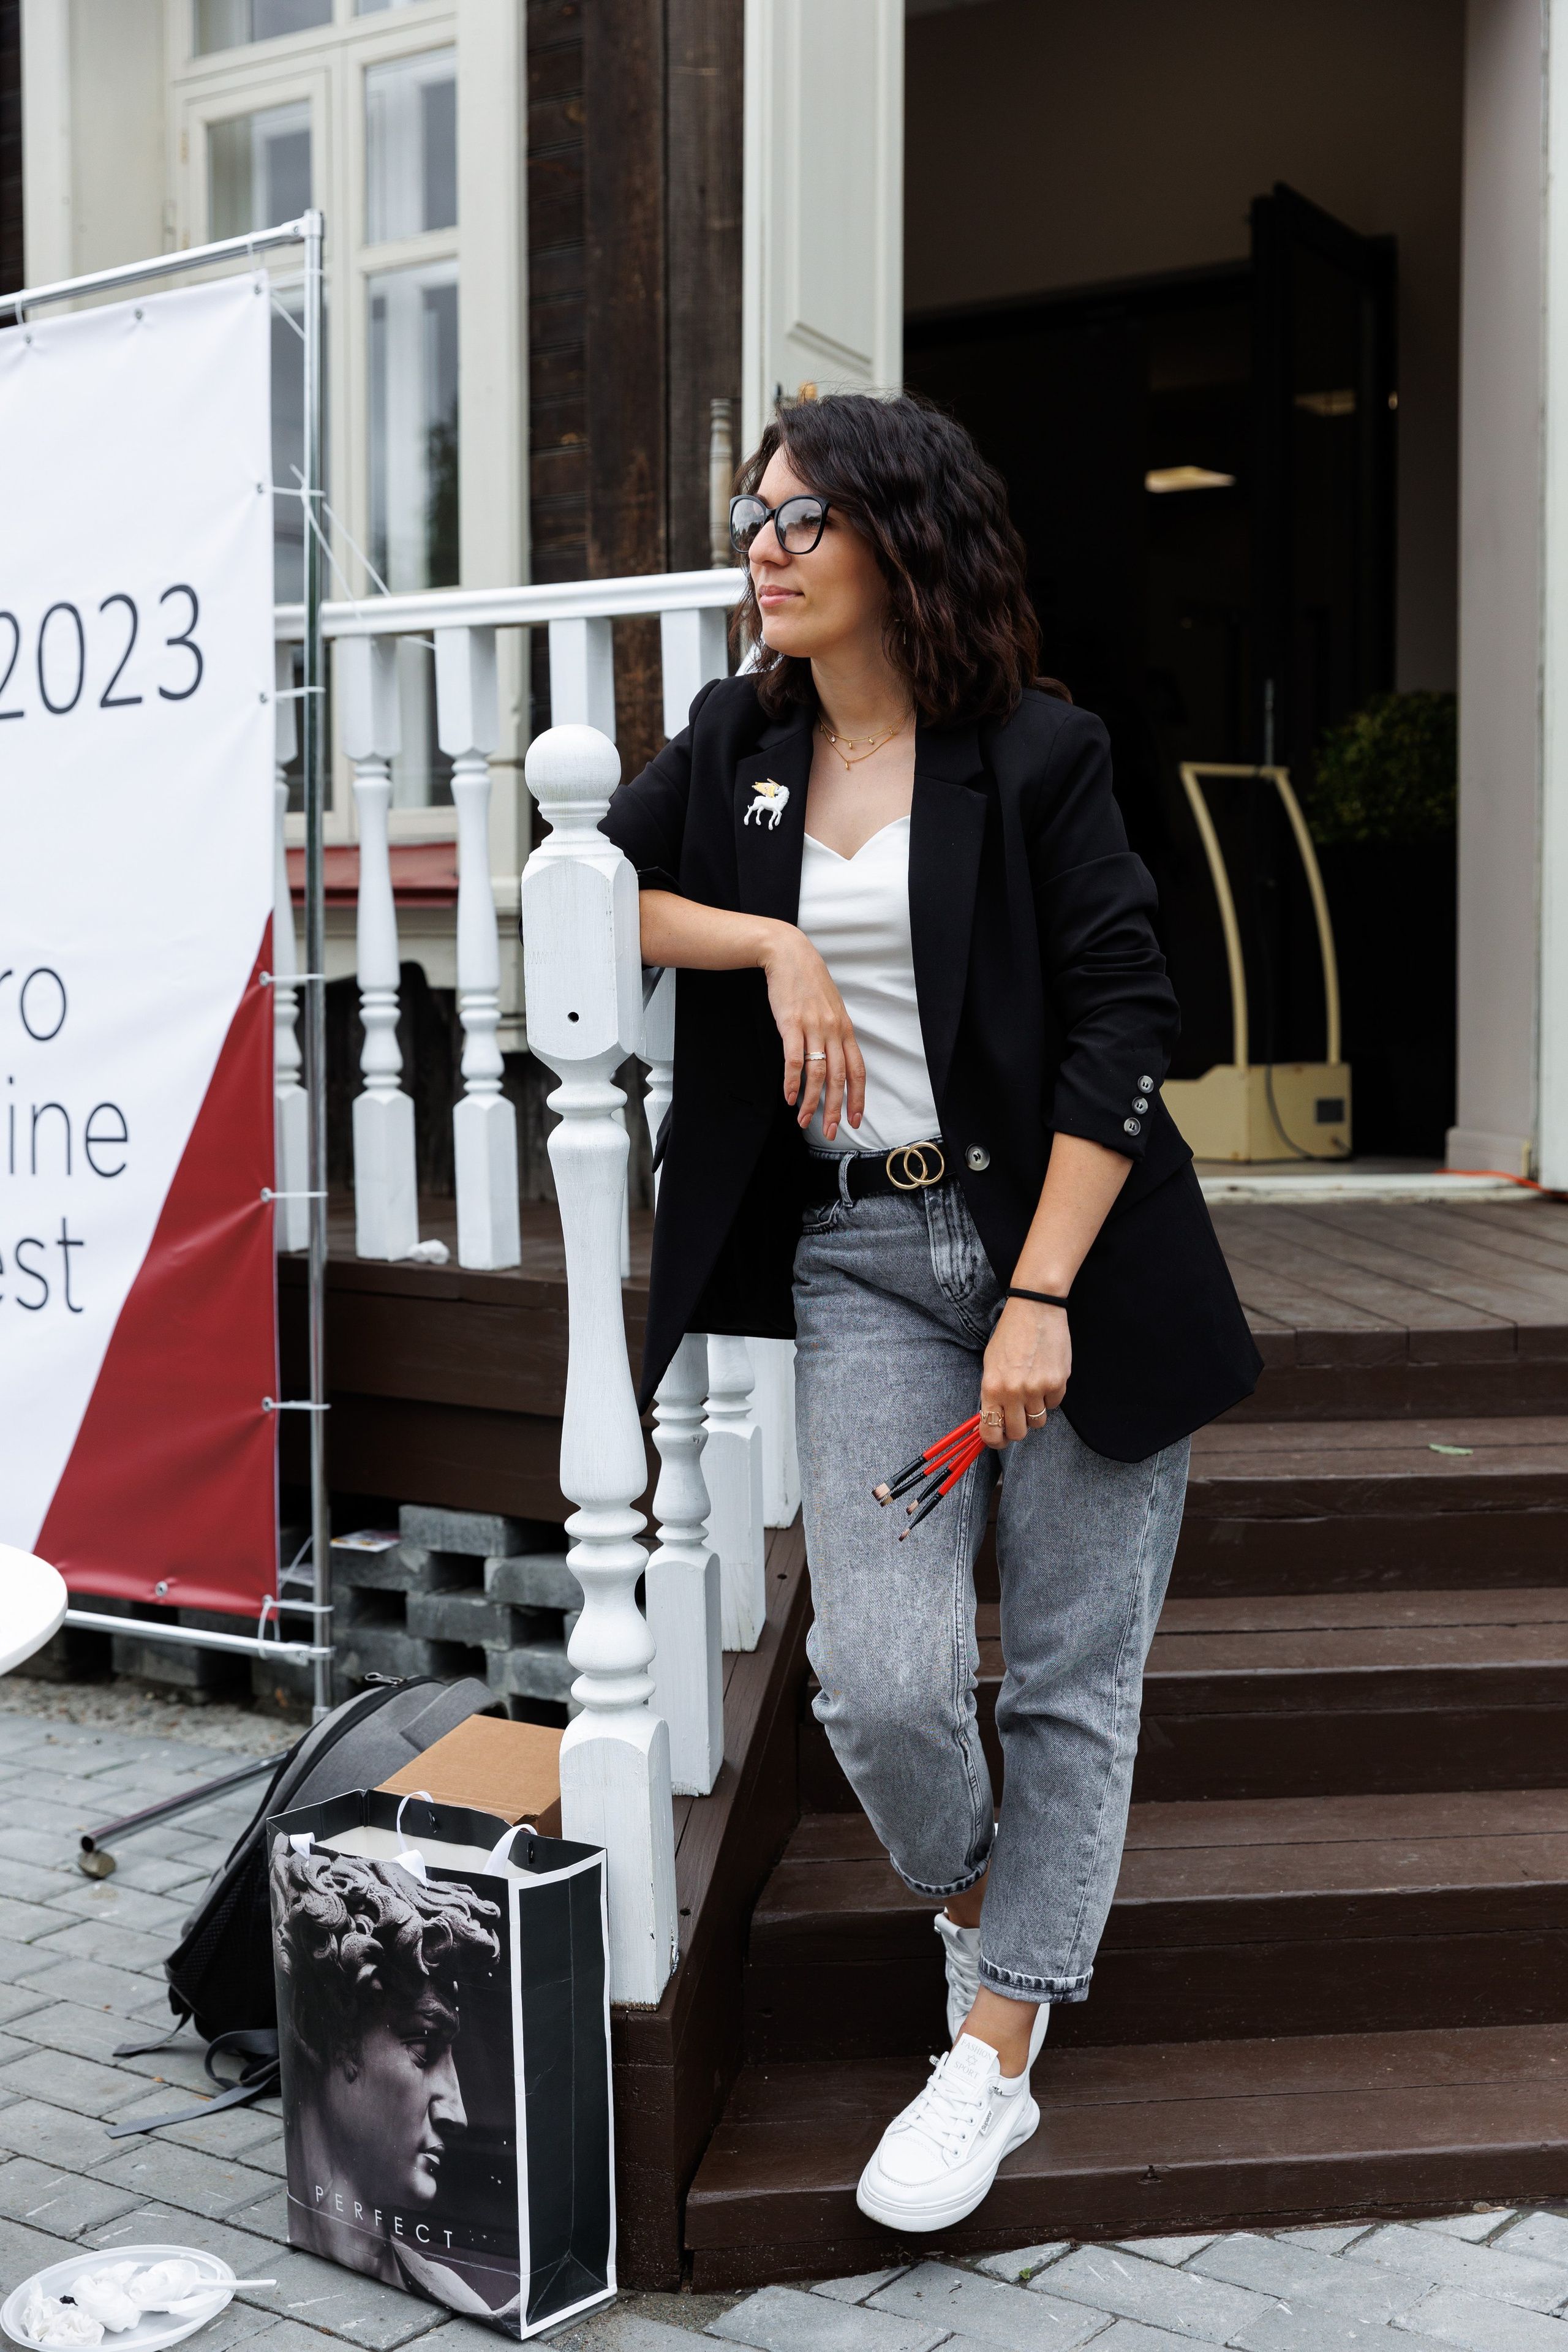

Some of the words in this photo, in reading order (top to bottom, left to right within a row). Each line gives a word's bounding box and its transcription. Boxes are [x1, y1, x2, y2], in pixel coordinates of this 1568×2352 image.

[0, 1216, 85, 1313] st
[953, 2060, 980, 2079] SPORT
[960, 2038, 992, 2060] FASHION
[315, 2185, 453, 2249] PERFECT
